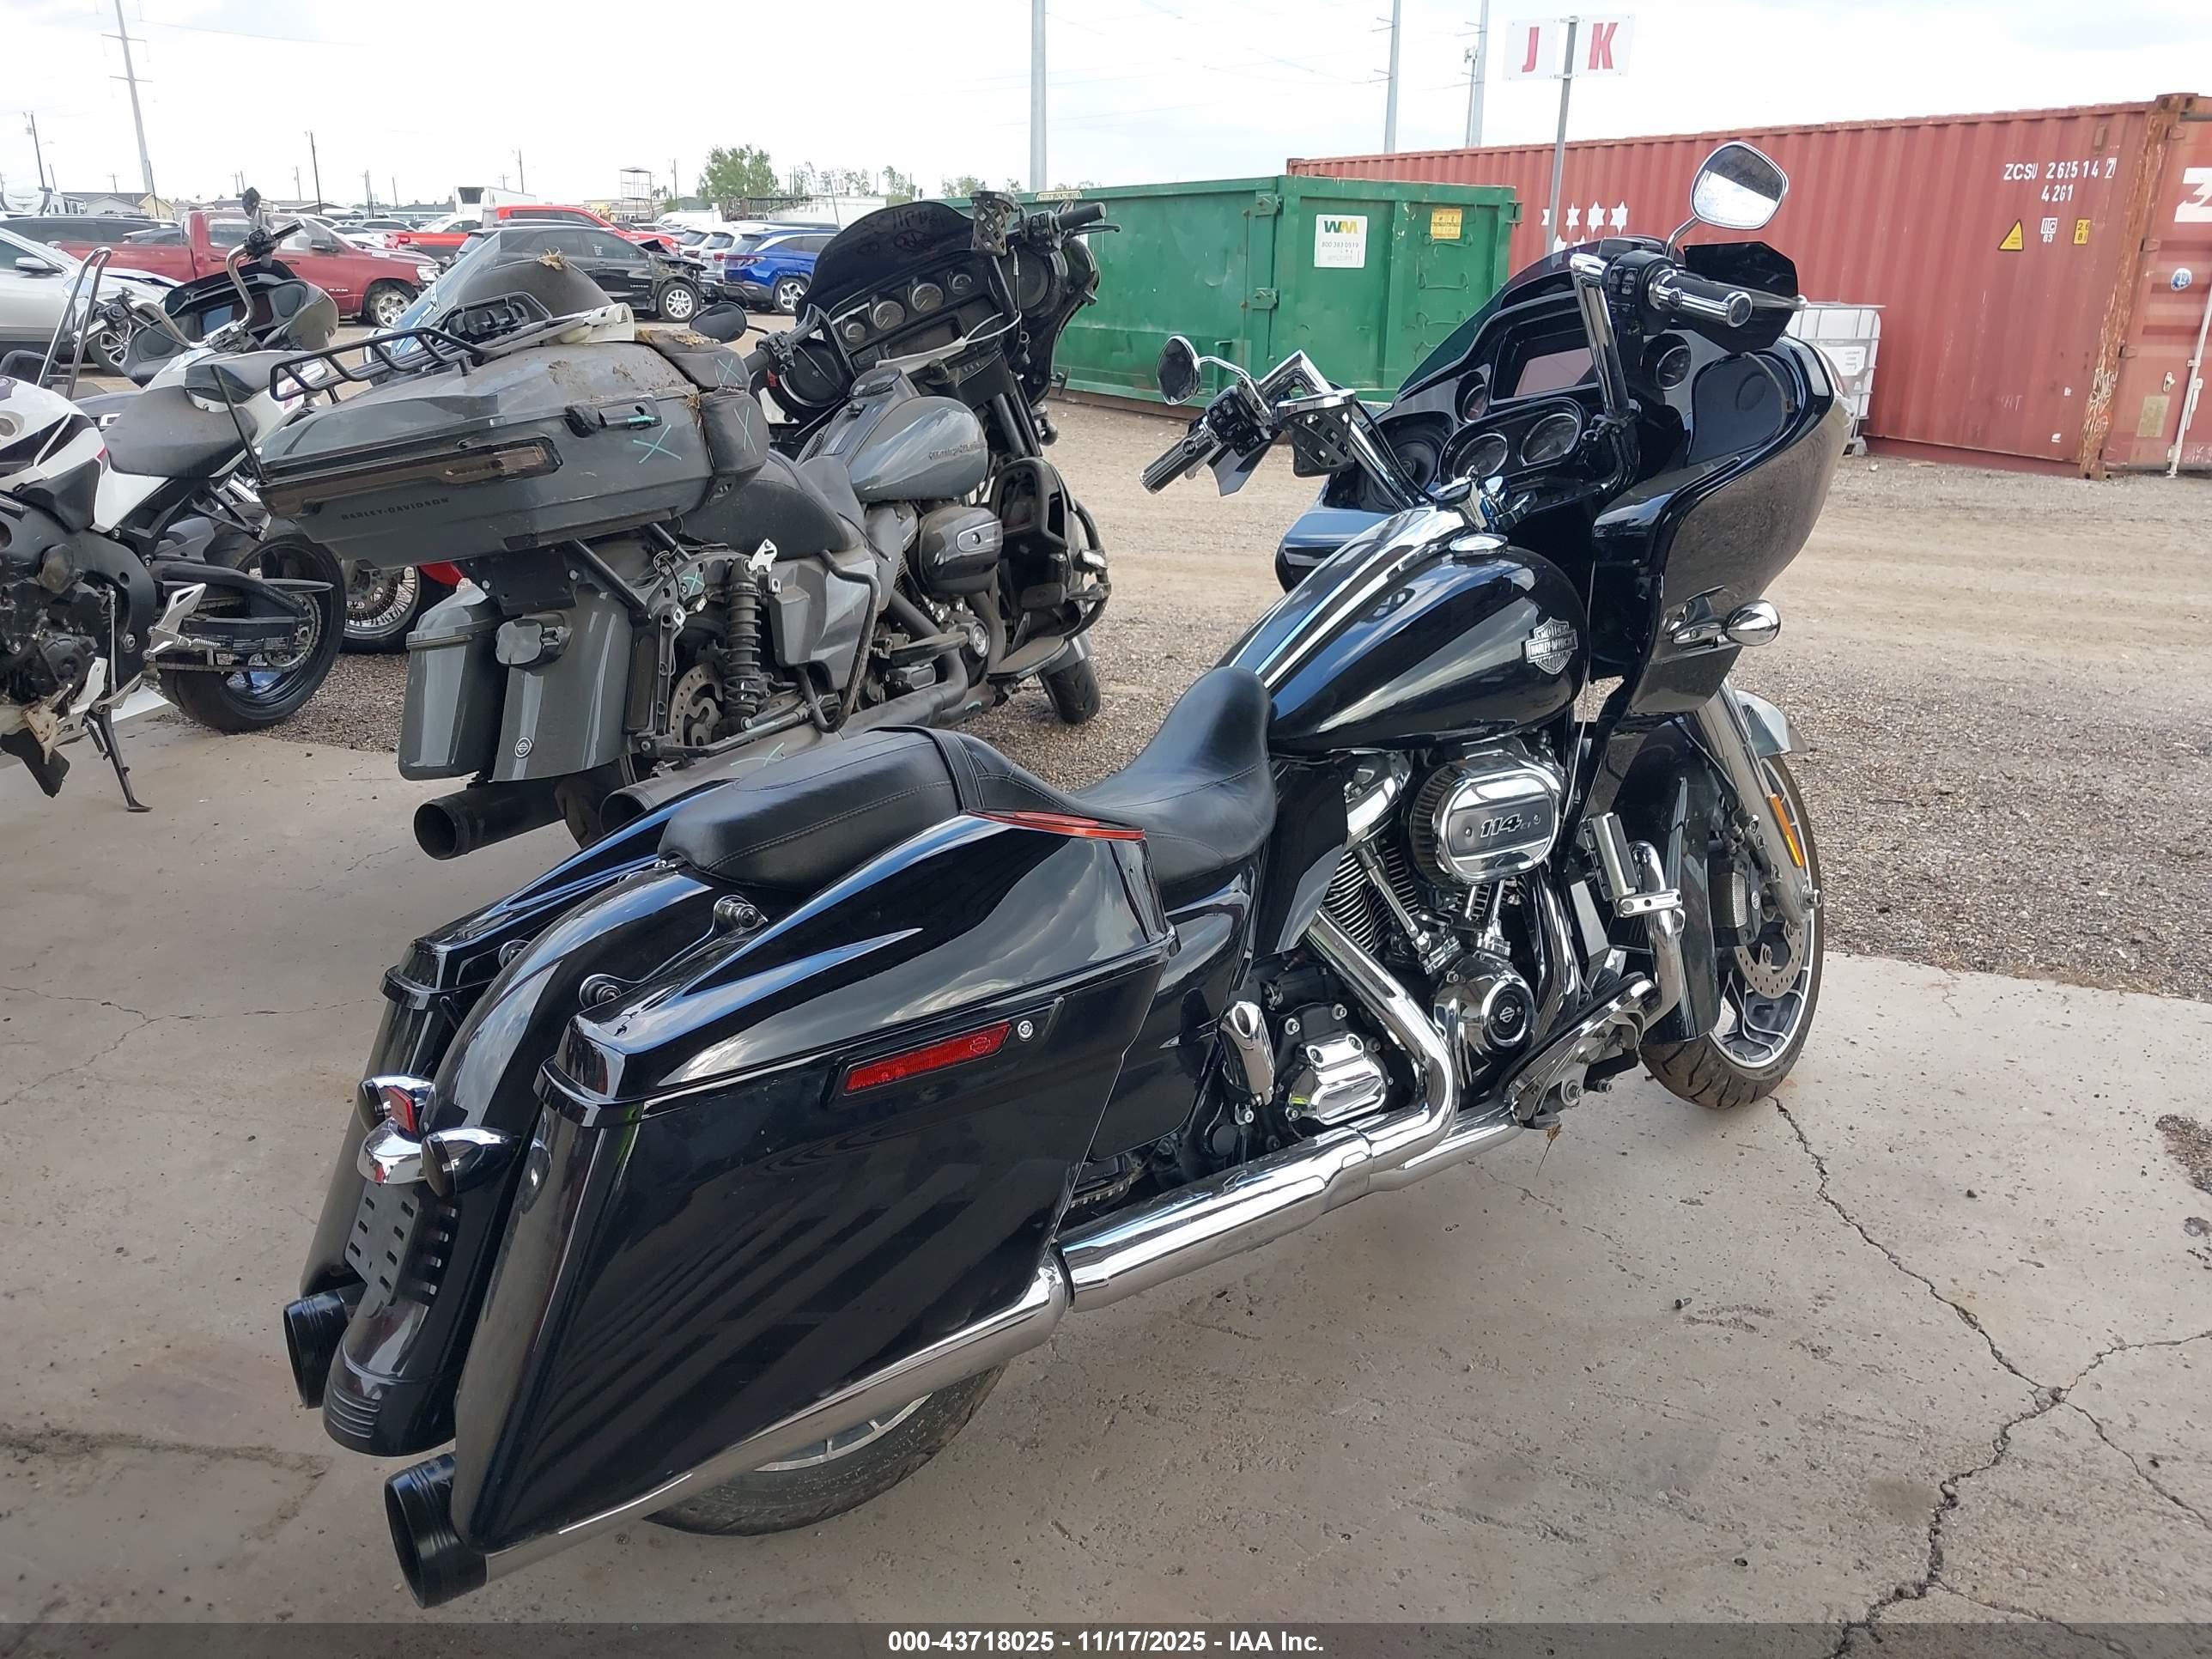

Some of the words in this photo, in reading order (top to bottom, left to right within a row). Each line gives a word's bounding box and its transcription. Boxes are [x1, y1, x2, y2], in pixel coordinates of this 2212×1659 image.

[1521, 27, 1540, 73] J
[1588, 22, 1620, 70] K
[2003, 162, 2039, 181] ZCSU
[1323, 220, 1358, 234] WM
[1480, 812, 1522, 838] 114
